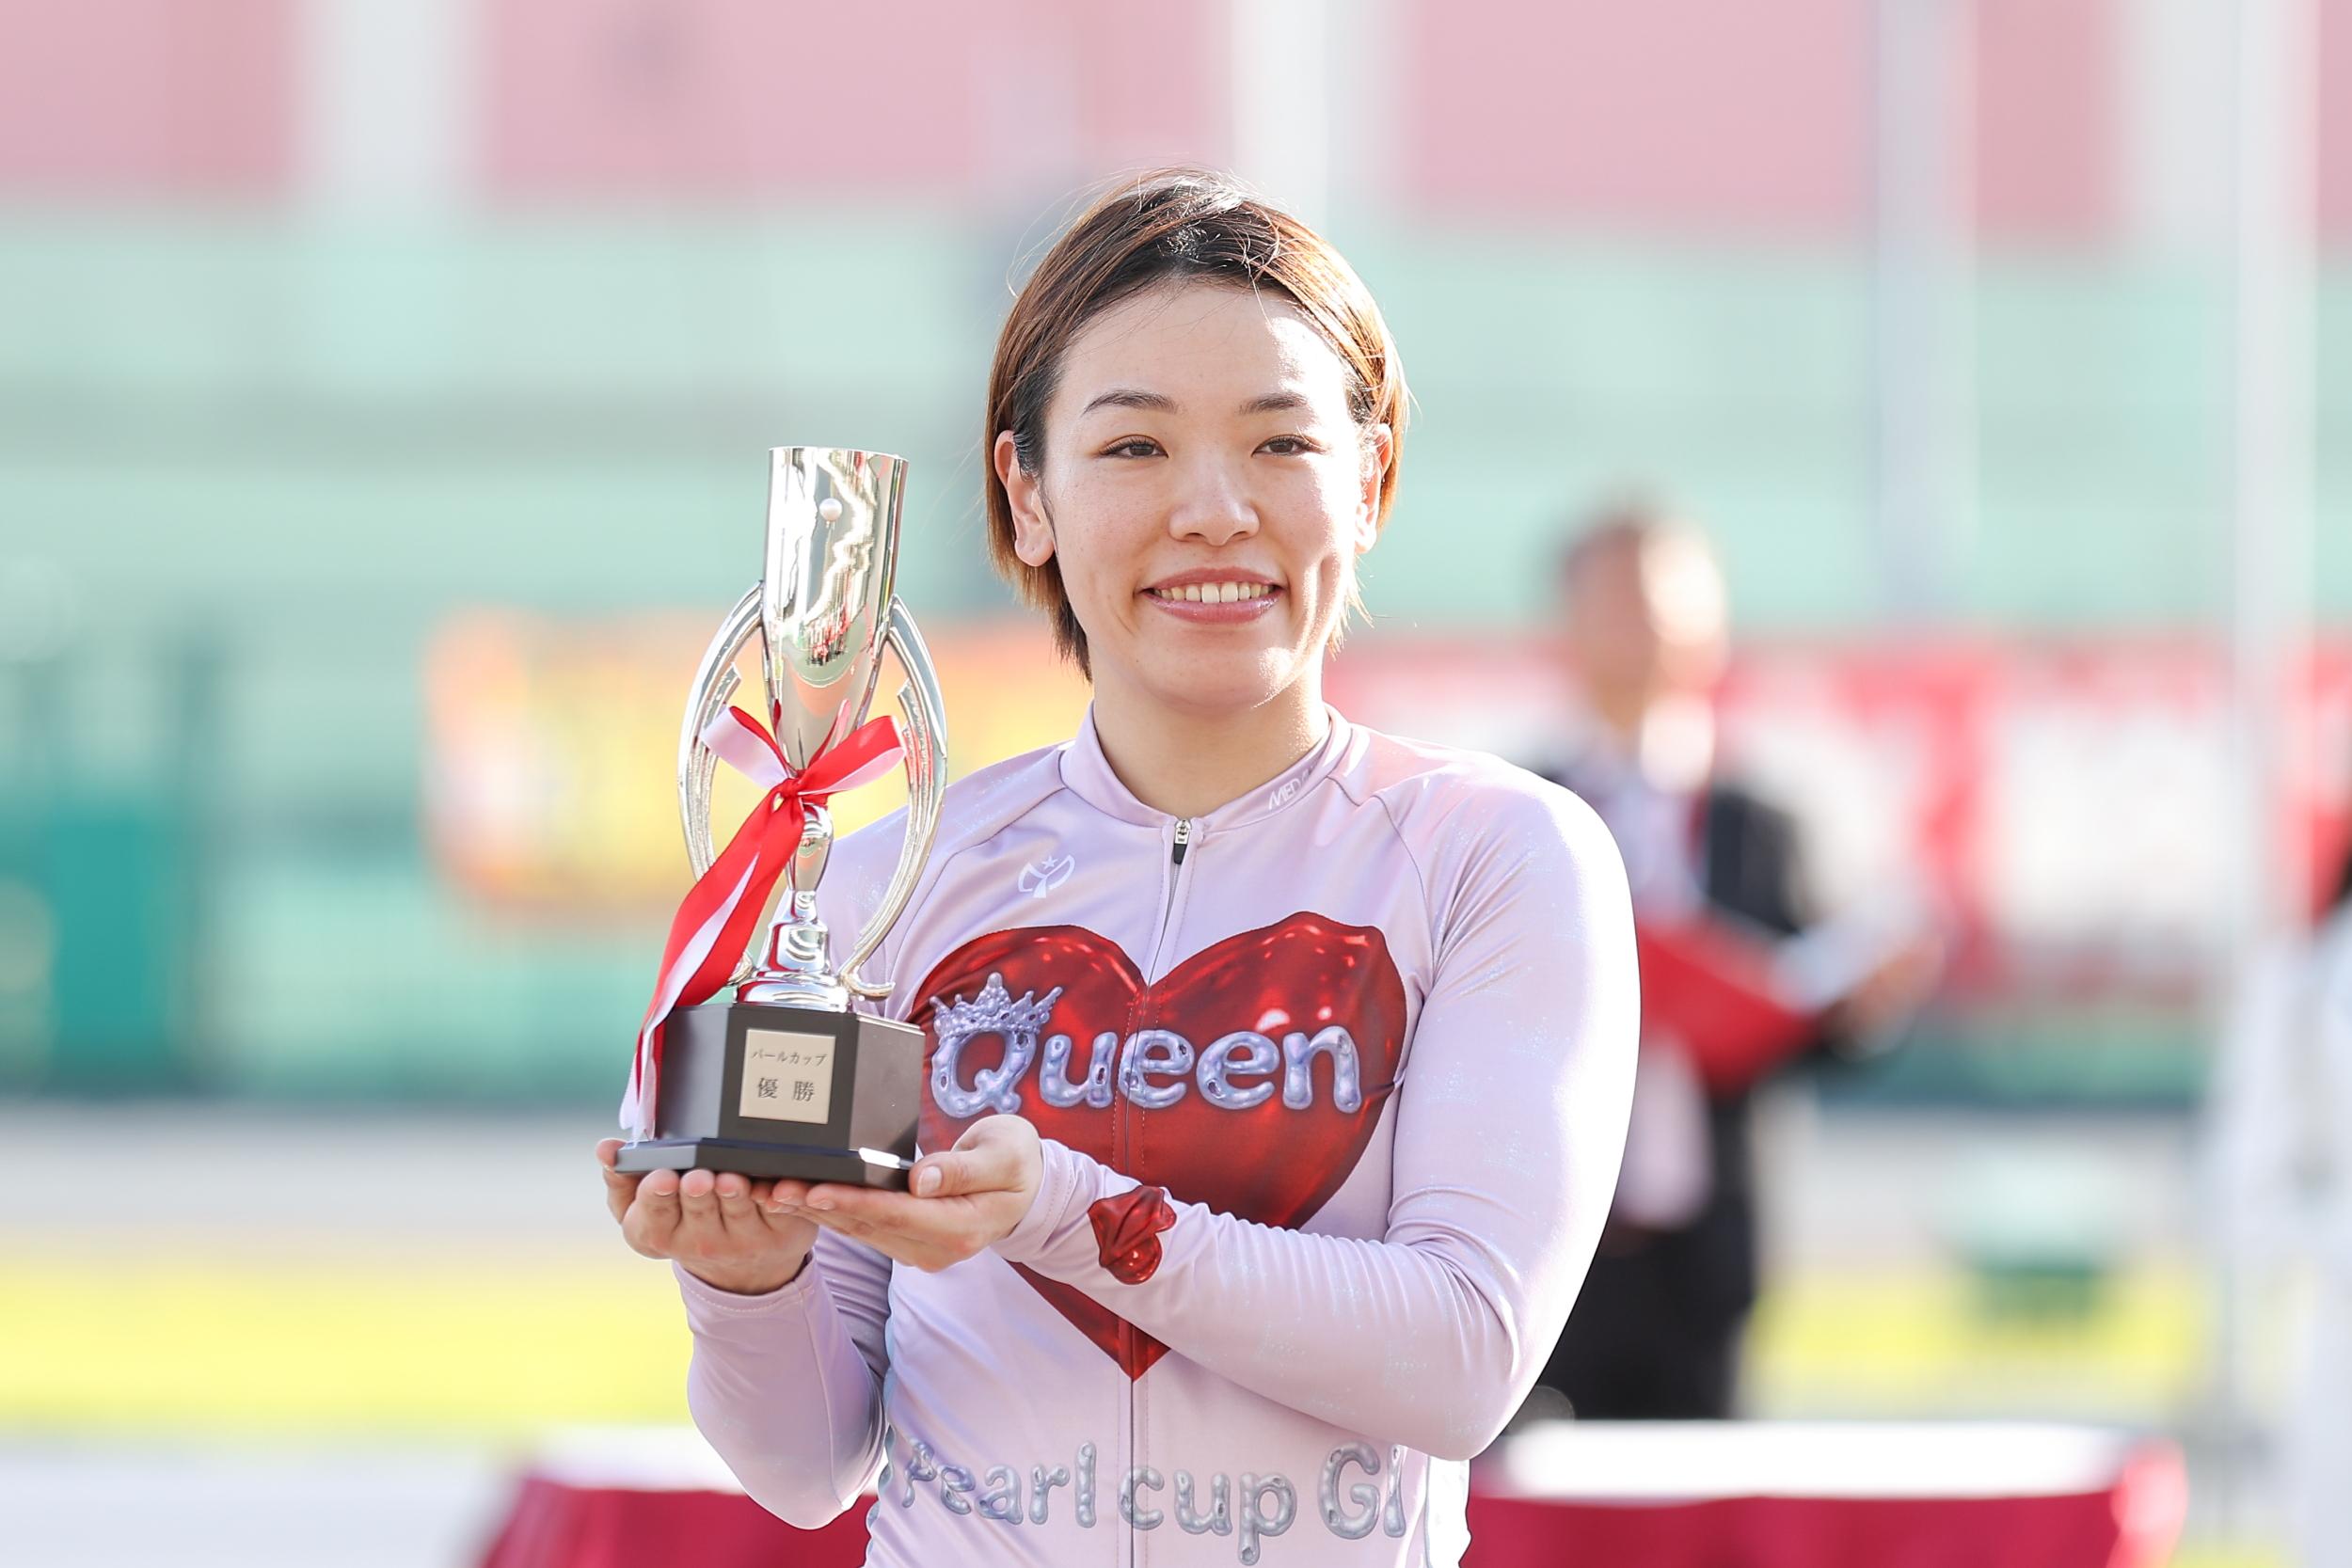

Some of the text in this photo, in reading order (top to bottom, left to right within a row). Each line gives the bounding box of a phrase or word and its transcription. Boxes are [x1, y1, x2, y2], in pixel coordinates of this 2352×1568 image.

[757, 1077, 815, 1102] 優勝
[929, 1023, 1362, 1118] Queen
[1118, 1465, 1297, 1566] cup
